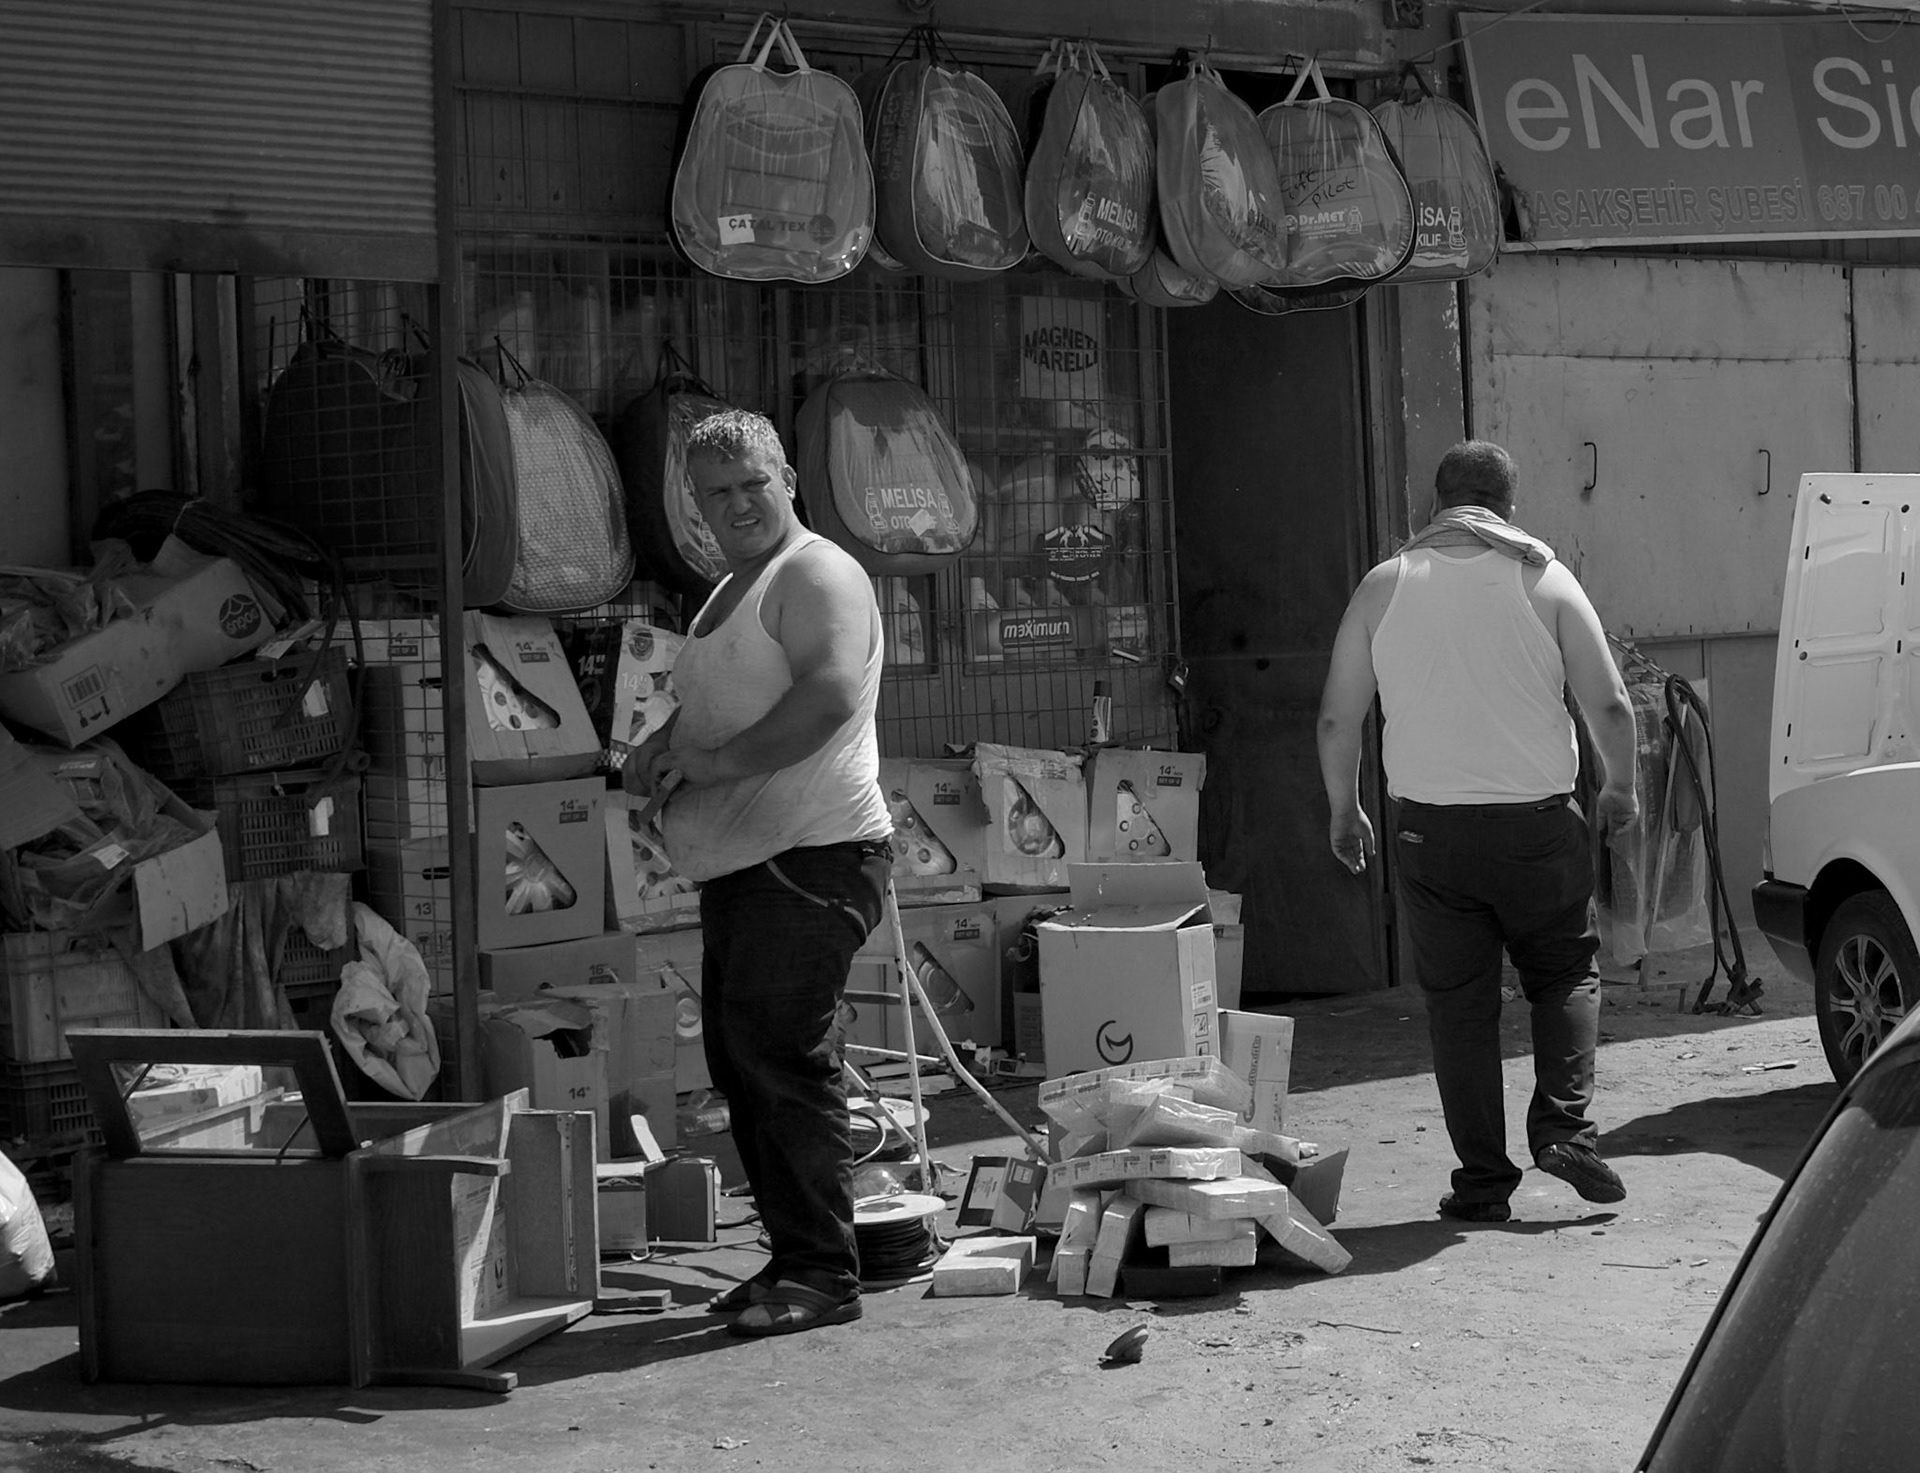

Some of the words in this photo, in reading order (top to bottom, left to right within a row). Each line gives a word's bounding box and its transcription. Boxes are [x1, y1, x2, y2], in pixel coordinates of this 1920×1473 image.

[1505, 54, 1764, 152] eNar
[1813, 57, 1920, 149] Si
[1708, 177, 1808, 230] ŞUBESİ
[1817, 184, 1866, 220] 687
[1874, 184, 1909, 220] 00
[780, 220, 806, 233] TEX
[881, 483, 938, 509] MELİSA
[415, 902, 432, 916] 13
